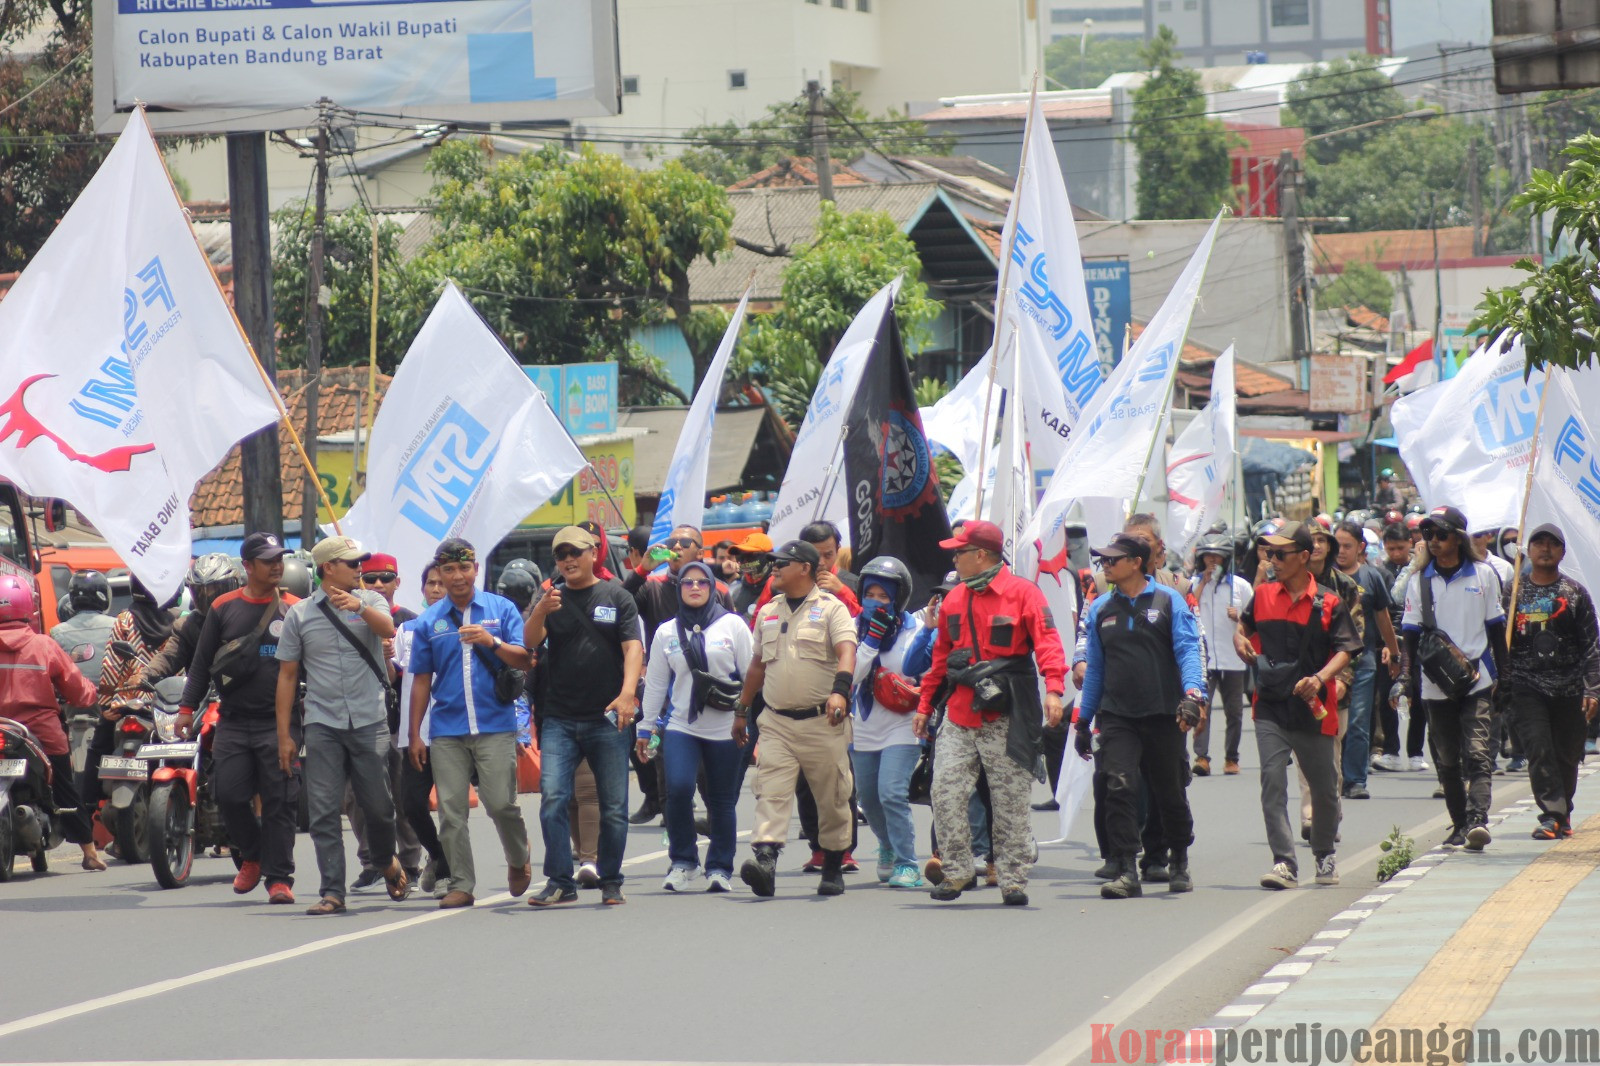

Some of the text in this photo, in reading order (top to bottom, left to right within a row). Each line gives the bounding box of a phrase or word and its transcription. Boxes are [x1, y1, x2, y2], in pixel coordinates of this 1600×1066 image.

[138, 18, 457, 46] Calon Bupati & Calon Wakil Bupati
[140, 45, 383, 70] Kabupaten Bandung Barat
[1093, 286, 1114, 380] DYNAMO
[587, 375, 607, 391] BASO
[585, 394, 608, 415] BOIM
[579, 453, 619, 495] BASO
[586, 494, 625, 530] BOIM
[855, 479, 873, 556] GOBSI
[1579, 494, 1600, 523] SERIKA
